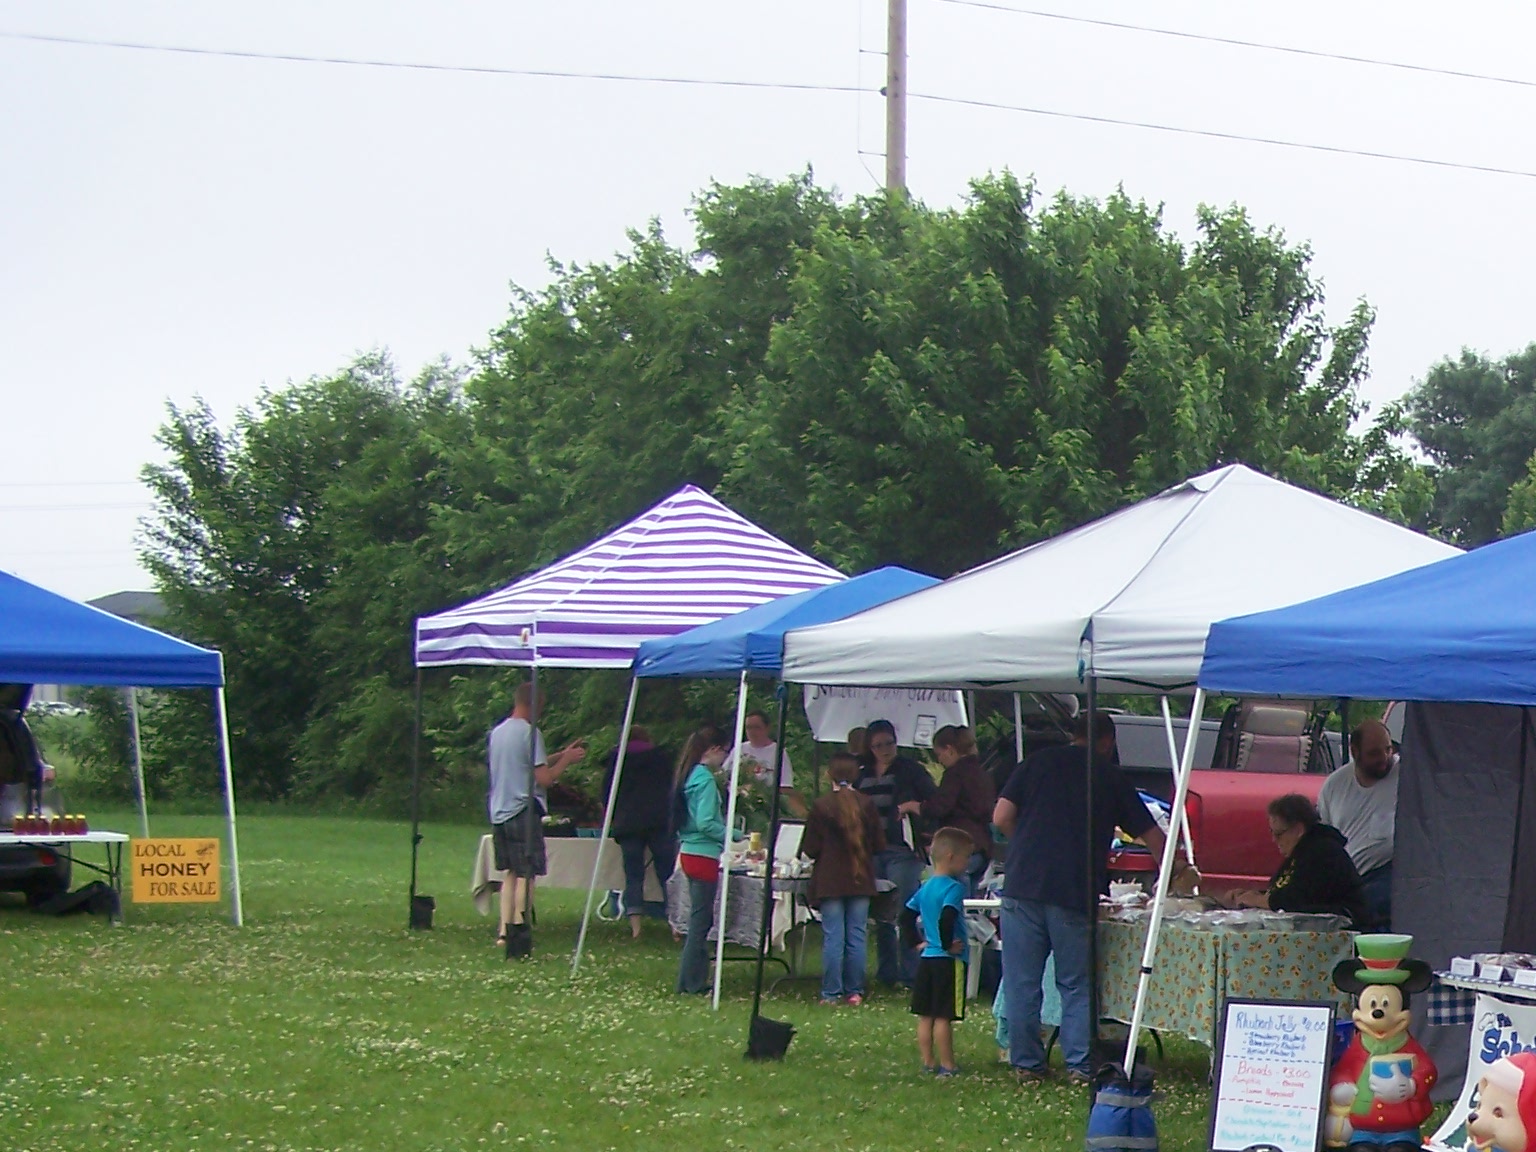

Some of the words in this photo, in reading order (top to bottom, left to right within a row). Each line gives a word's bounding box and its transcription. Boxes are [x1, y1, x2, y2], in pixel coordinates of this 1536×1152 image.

[135, 844, 186, 857] LOCAL
[140, 862, 211, 877] HONEY
[149, 881, 178, 897] FOR
[180, 881, 217, 896] SALE
[1237, 1060, 1272, 1076] Breads
